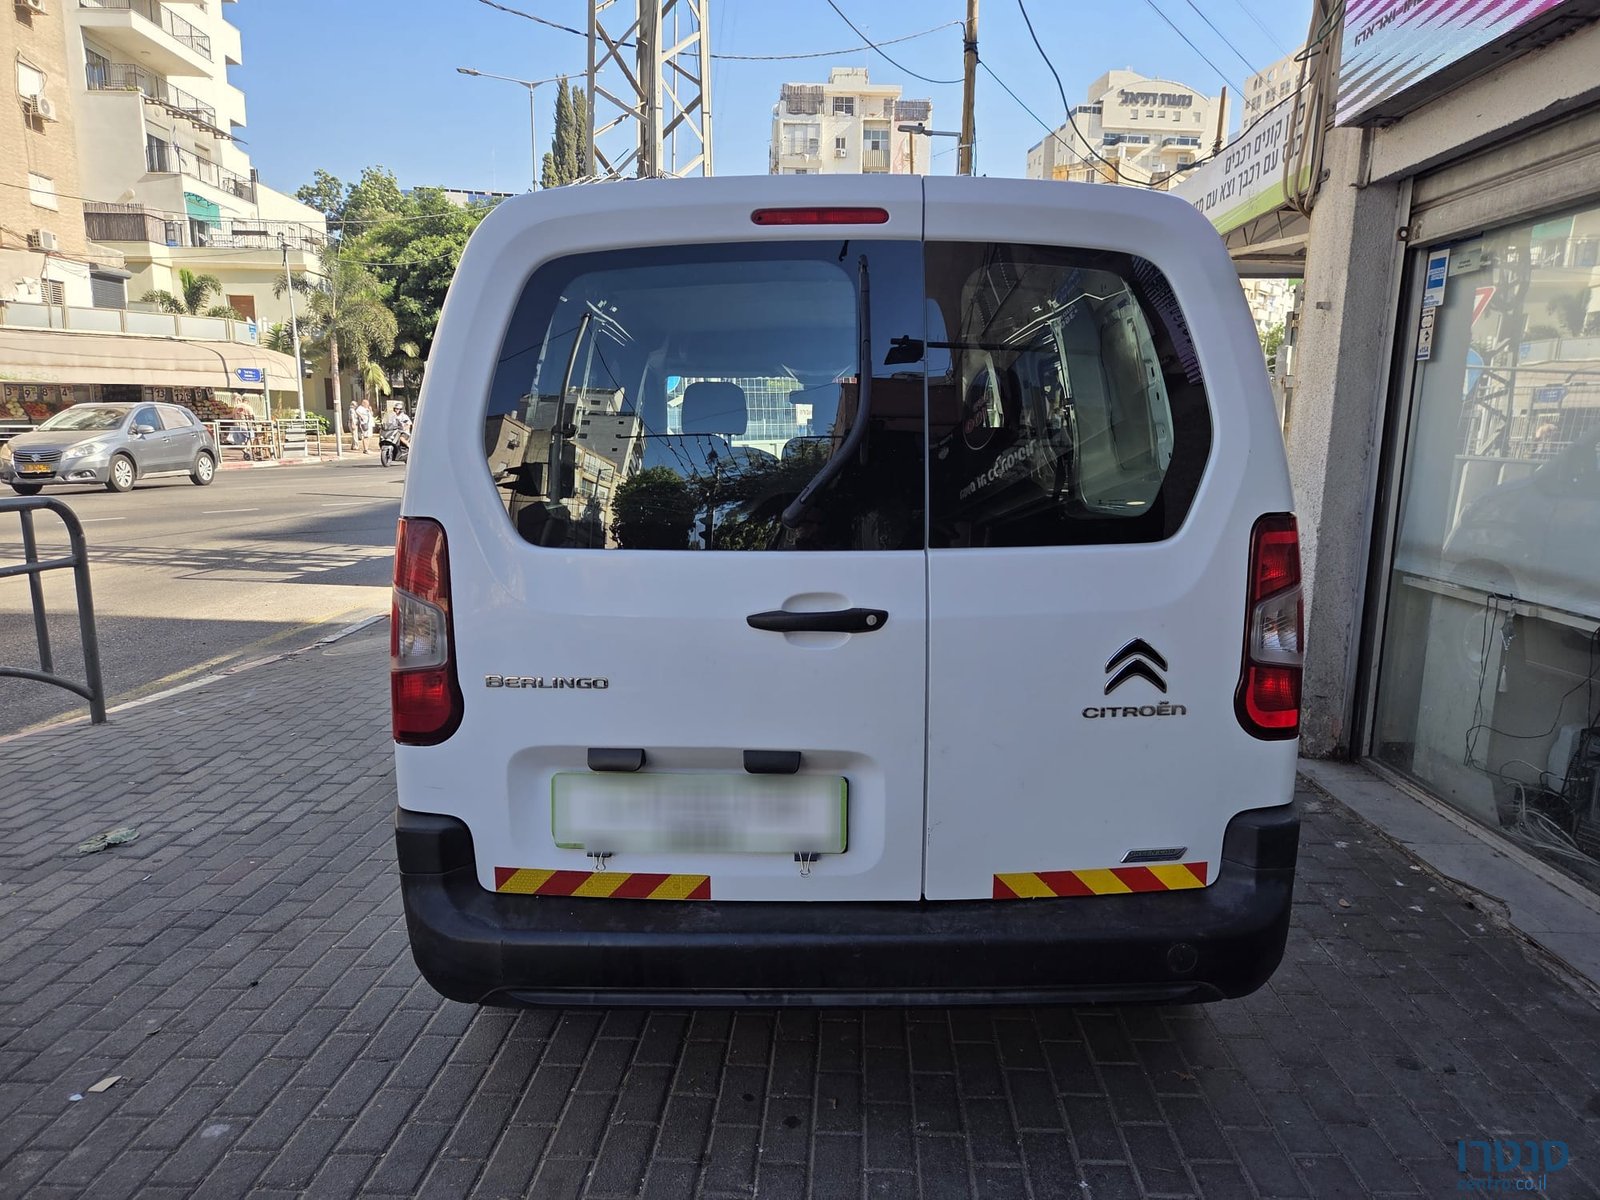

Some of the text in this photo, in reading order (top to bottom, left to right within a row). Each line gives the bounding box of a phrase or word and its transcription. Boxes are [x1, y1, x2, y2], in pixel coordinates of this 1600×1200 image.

[1254, 119, 1282, 157] קונים
[1225, 142, 1252, 175] רכבים
[1263, 148, 1279, 175] עם
[1219, 177, 1235, 202] וצא
[1238, 161, 1261, 196] רכבך
[1206, 188, 1218, 211] עם
[484, 674, 609, 690] BERLINGO
